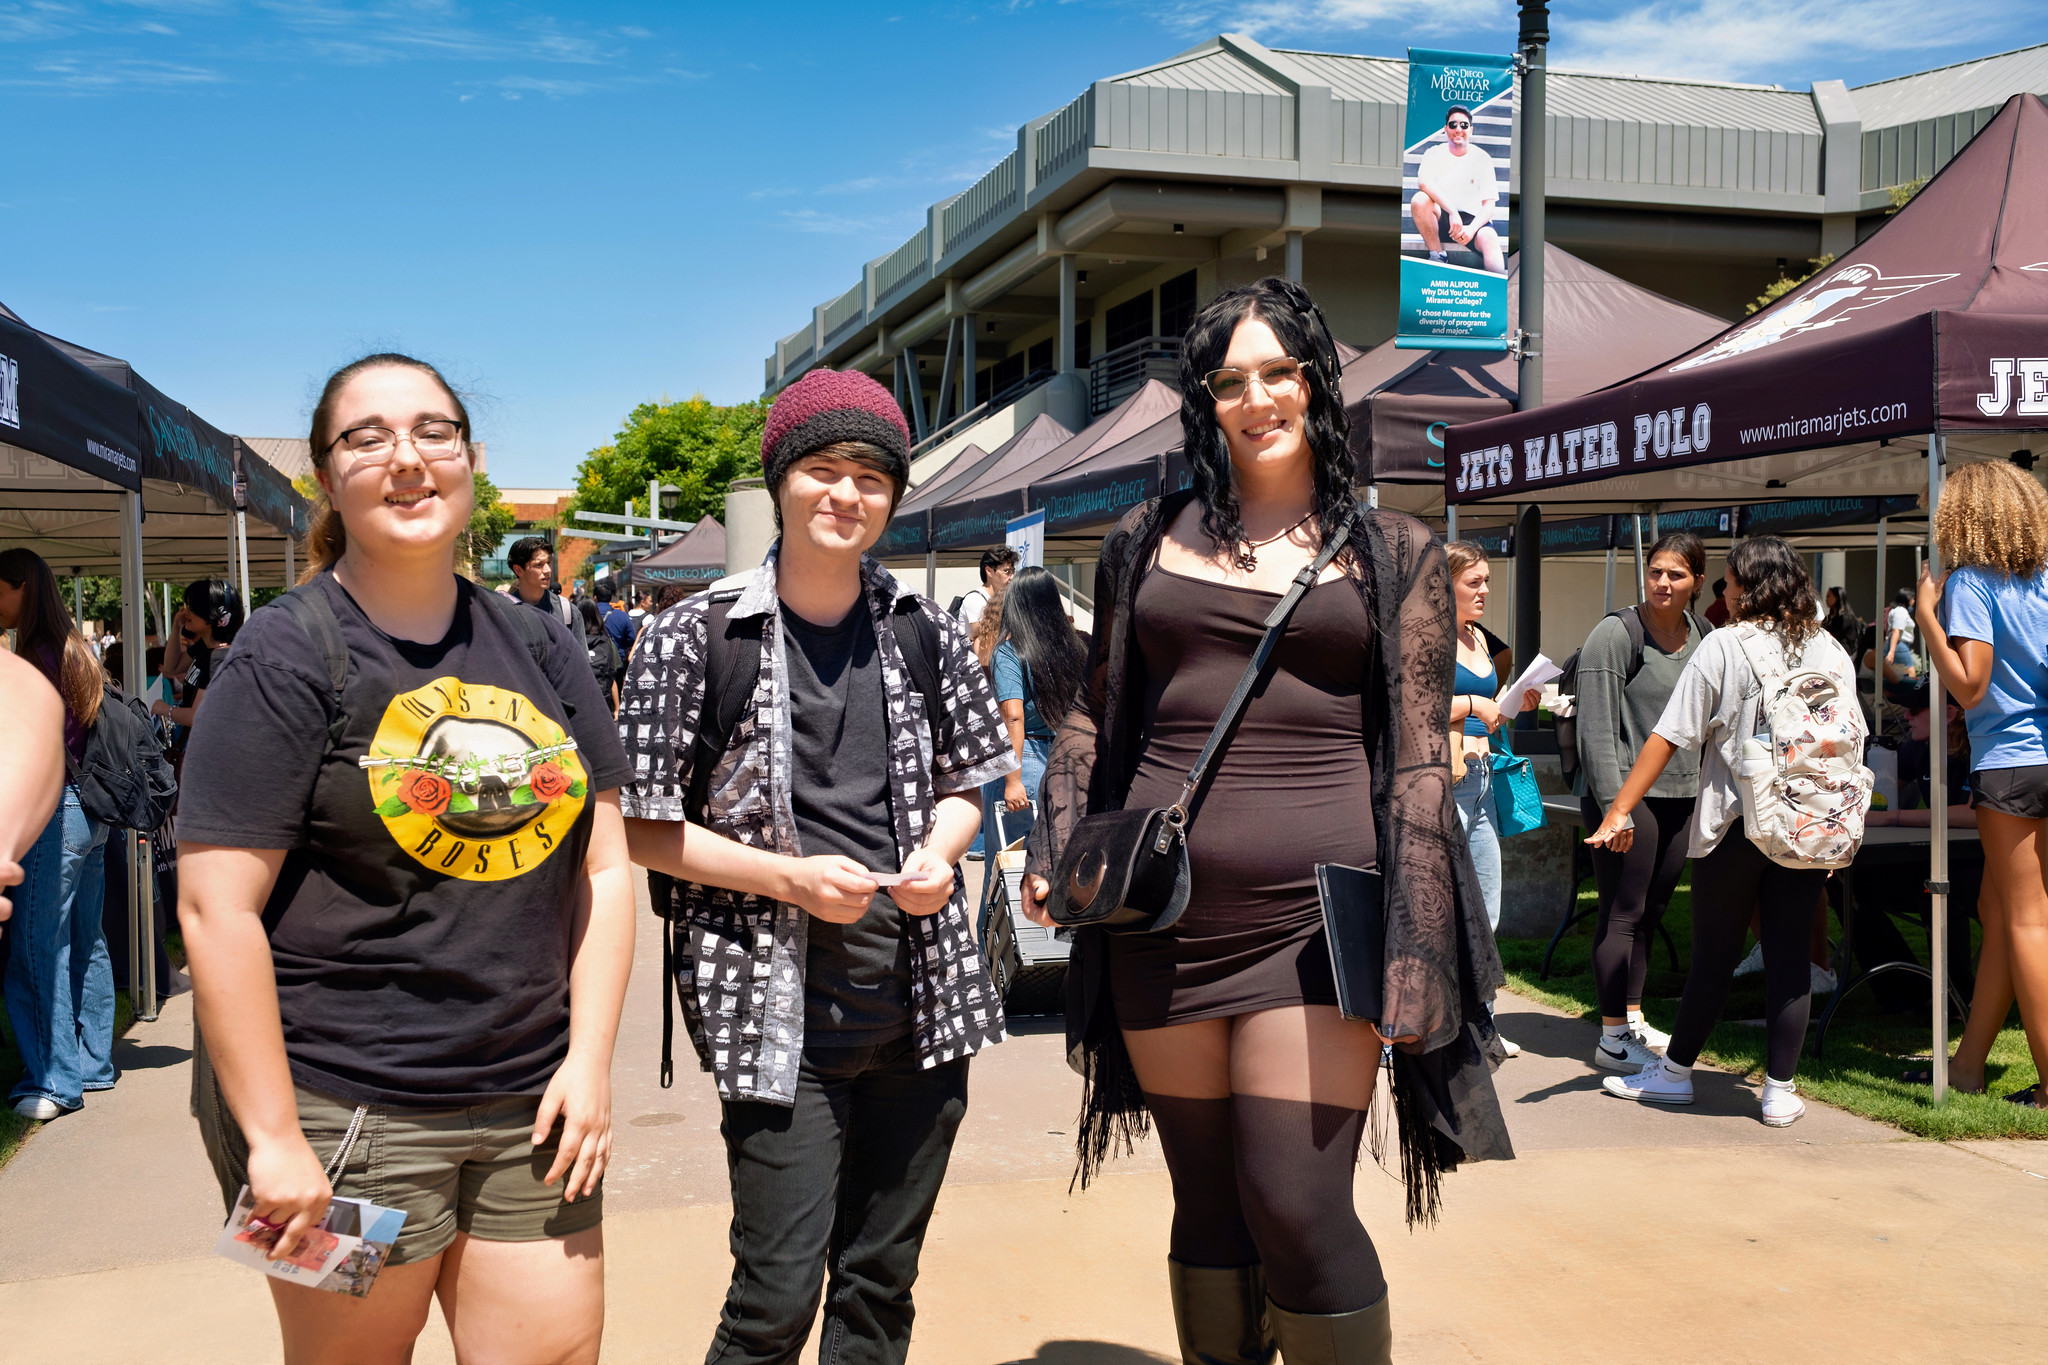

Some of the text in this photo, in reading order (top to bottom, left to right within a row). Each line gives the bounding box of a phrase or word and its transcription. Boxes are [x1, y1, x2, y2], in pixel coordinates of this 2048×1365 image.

[1443, 66, 1484, 79] SAN DIEGO
[1430, 73, 1490, 91] MIRAMAR
[1441, 87, 1484, 103] COLLEGE
[1430, 280, 1479, 289] AMIN ALIPOUR
[1421, 288, 1488, 298] Why Did You Choose
[1426, 296, 1483, 307] Miramar College?
[1422, 309, 1441, 317] chose
[1442, 310, 1469, 318] Miramar
[1469, 310, 1479, 318] for
[1480, 311, 1491, 319] the
[1419, 318, 1487, 328] diversity of programs
[1431, 327, 1445, 335] and
[1739, 402, 1907, 444] www.miramarjets.com
[86, 438, 137, 472] www.miramarjets.com
[1456, 402, 1712, 492] JETS WATER POLO
[1049, 496, 1071, 522] DIEGO
[1070, 488, 1108, 519] MIRAMAR
[1107, 479, 1145, 512] COLLEGE
[1784, 499, 1824, 519] MIRAMAR
[1823, 498, 1863, 516] COLLEGE
[1684, 510, 1719, 531] COLLEGE
[644, 567, 667, 580] SAN
[667, 568, 699, 580] DIEGO
[414, 821, 553, 874] ROSES
